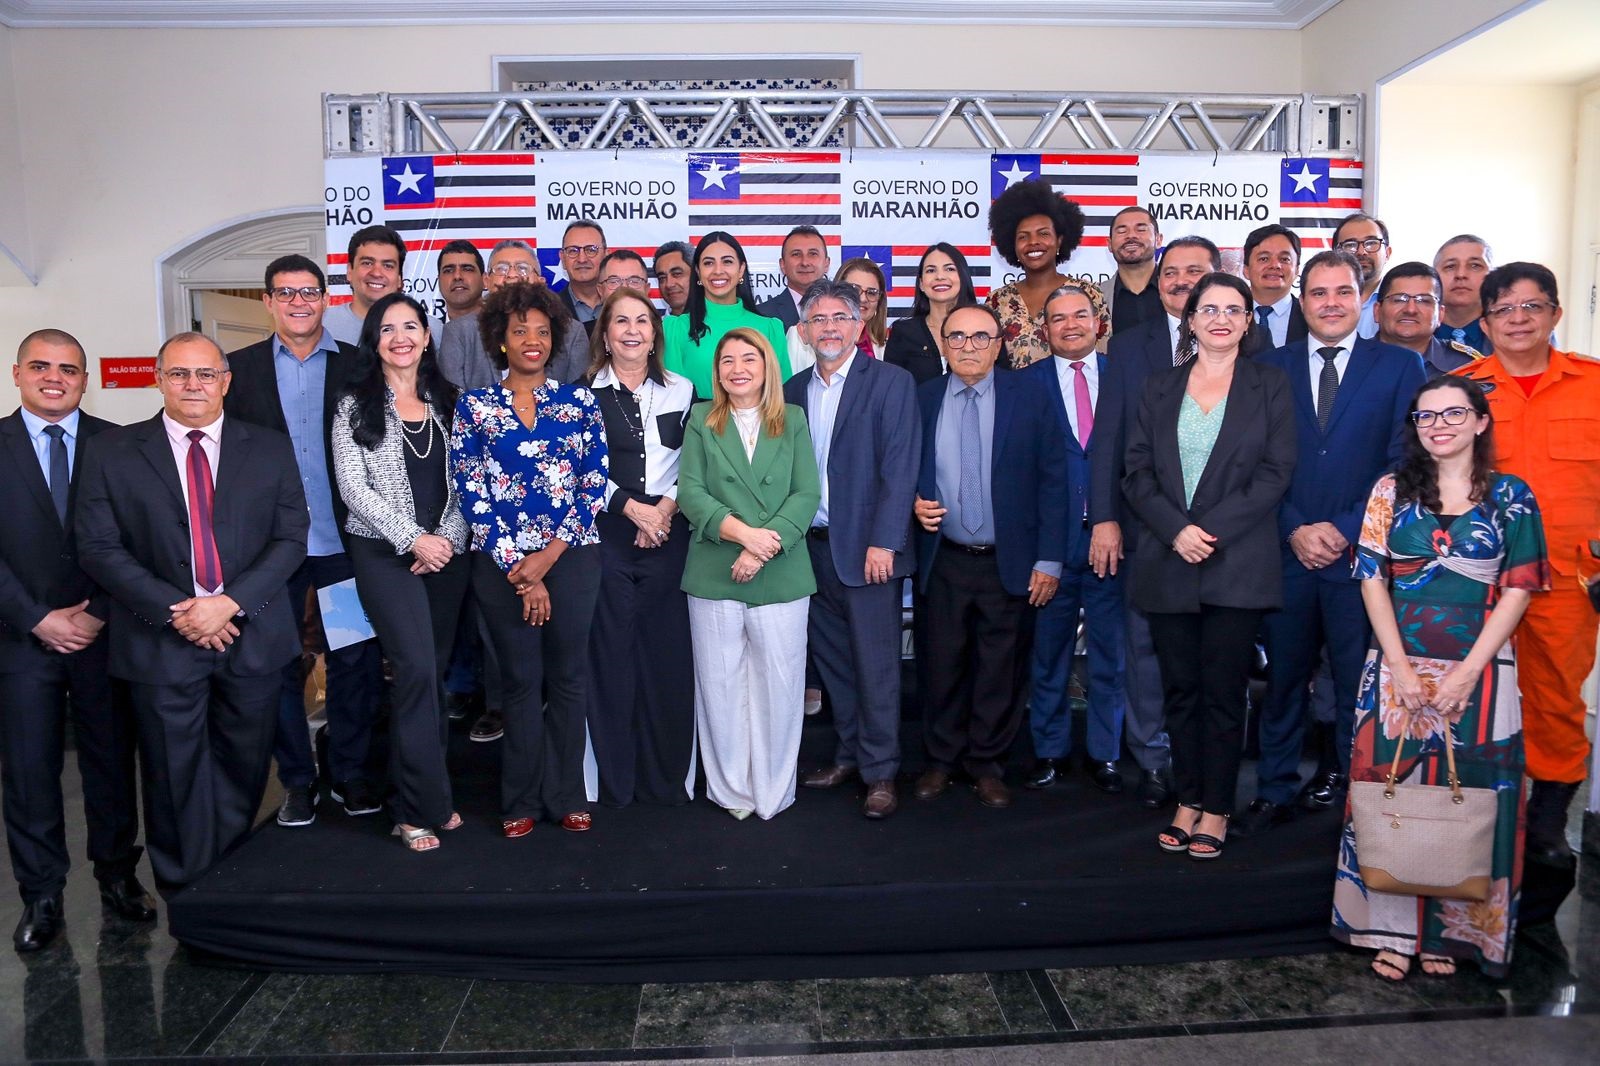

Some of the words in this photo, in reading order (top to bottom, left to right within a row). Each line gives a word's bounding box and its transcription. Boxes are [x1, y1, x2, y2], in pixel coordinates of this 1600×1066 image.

[343, 186, 371, 202] DO
[548, 180, 643, 196] GOVERNO
[648, 180, 676, 196] DO
[853, 180, 946, 195] GOVERNO
[951, 180, 979, 196] DO
[1148, 182, 1239, 198] GOVERNO
[1243, 183, 1269, 198] DO
[547, 198, 678, 220] MARANHÃO
[852, 197, 980, 219] MARANHÃO
[1147, 200, 1270, 221] MARANHÃO
[109, 365, 128, 374] SALÃO
